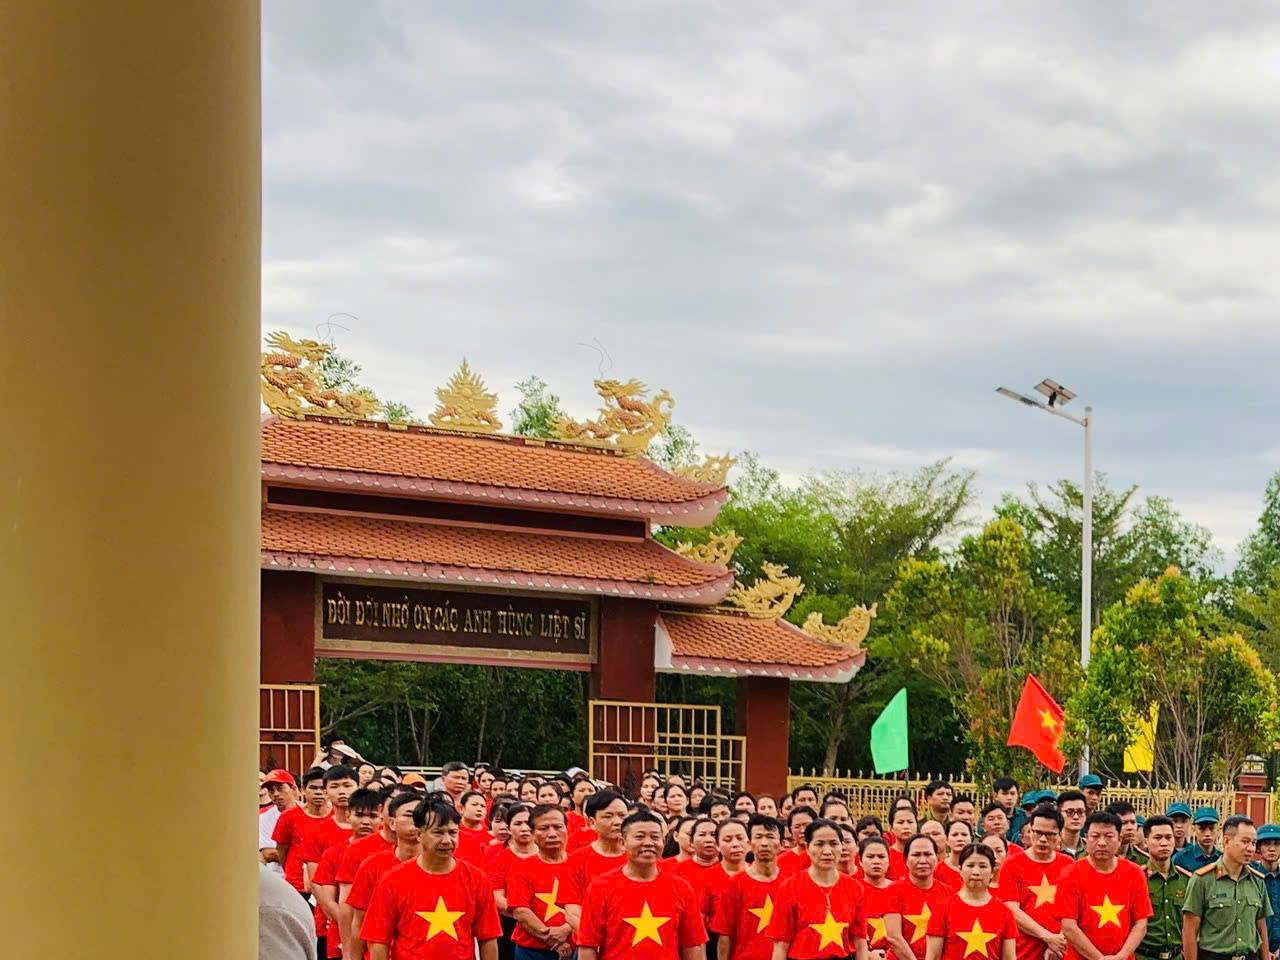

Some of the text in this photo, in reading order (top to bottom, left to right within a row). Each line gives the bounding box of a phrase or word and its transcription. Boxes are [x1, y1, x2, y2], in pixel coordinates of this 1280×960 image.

[434, 600, 458, 632] CÁC
[463, 608, 492, 633] ANH
[497, 603, 533, 636] HÙNG
[540, 609, 570, 644] LIỆT
